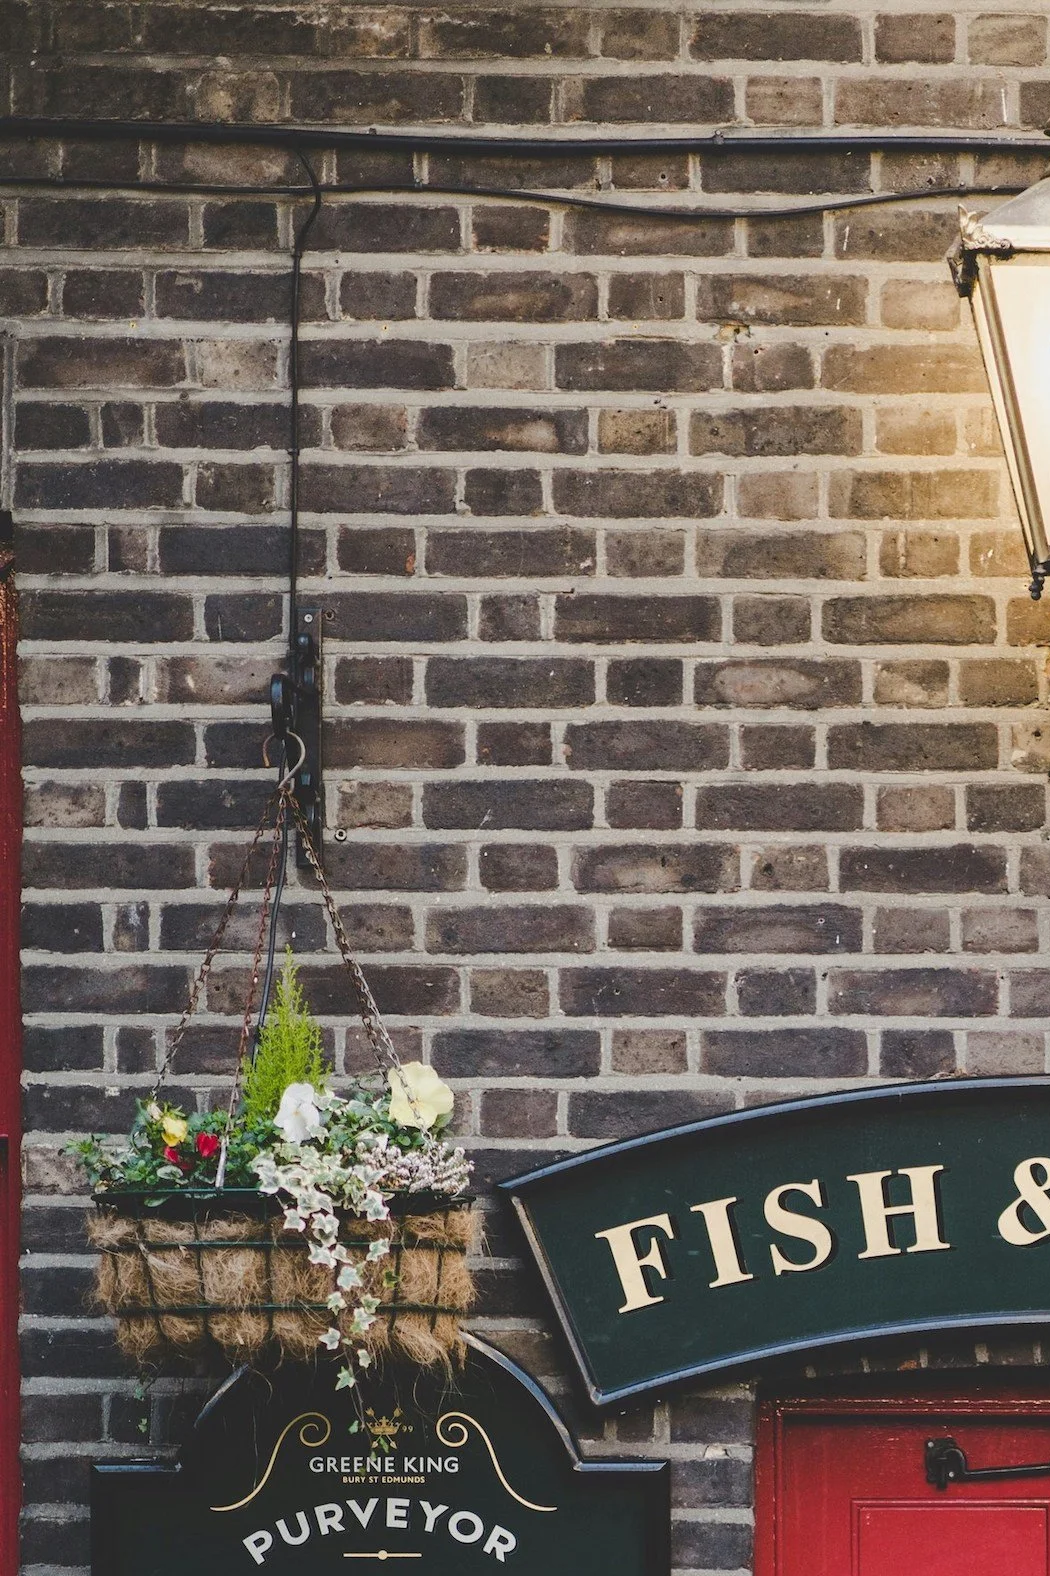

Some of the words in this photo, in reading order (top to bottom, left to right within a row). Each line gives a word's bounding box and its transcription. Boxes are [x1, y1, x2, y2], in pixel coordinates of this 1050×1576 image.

[595, 1163, 952, 1315] FISH
[309, 1456, 395, 1473] GREENE
[403, 1456, 459, 1473] KING
[342, 1476, 366, 1484] BURY
[369, 1476, 379, 1484] ST
[381, 1476, 426, 1484] EDMUNDS
[242, 1497, 518, 1565] PURVEYOR
